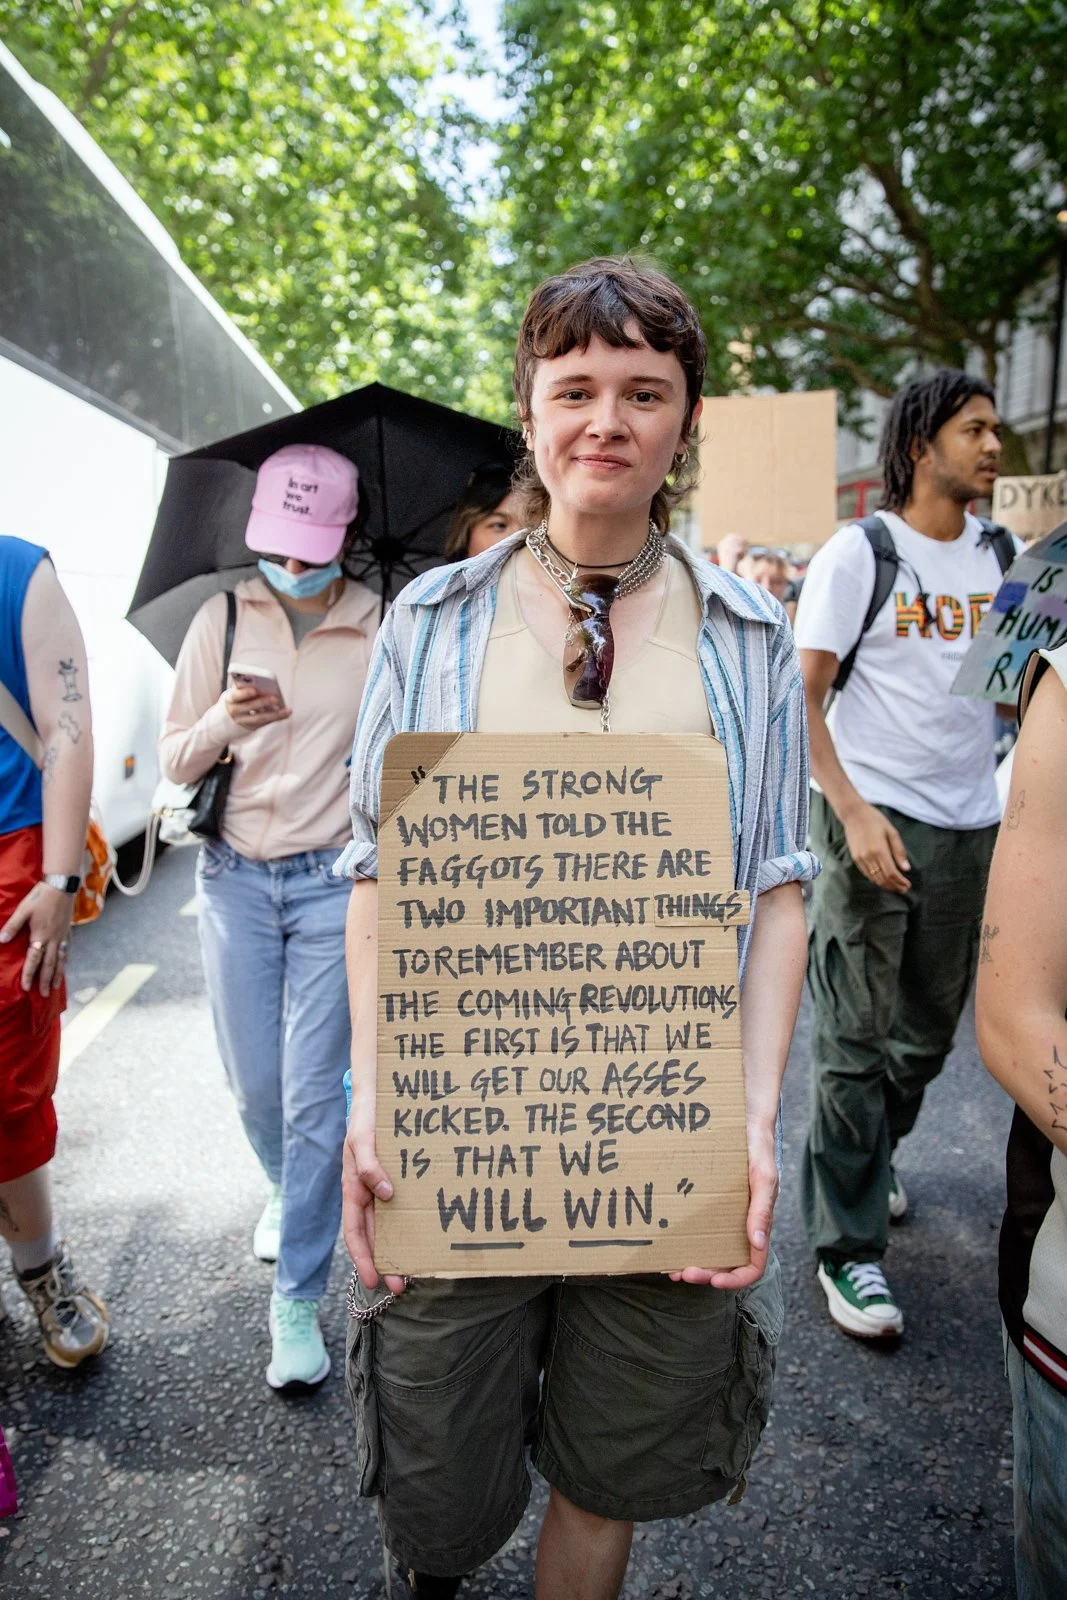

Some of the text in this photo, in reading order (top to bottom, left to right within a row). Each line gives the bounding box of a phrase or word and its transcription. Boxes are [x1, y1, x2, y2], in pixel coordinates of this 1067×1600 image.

[286, 491, 303, 502] we
[300, 484, 319, 494] art
[1031, 566, 1063, 592] IS
[522, 766, 663, 802] STRONG
[397, 810, 673, 849] WOMEN TOLD THE
[397, 848, 712, 889] FAGGOTS THERE ARE
[396, 892, 743, 930] TWO IMPORTANT THINGS
[391, 939, 706, 980] TO REMEMBER ABOUT
[380, 982, 738, 1026] THE COMING REVOLUTIONS
[394, 1021, 713, 1060] THE FIRST IS THAT WE
[392, 1058, 707, 1102] WILL GET OUR ASSES
[393, 1101, 711, 1138] KICKED. THE SECOND
[400, 1139, 620, 1179] IS THAT WE
[436, 1186, 548, 1233] WILL
